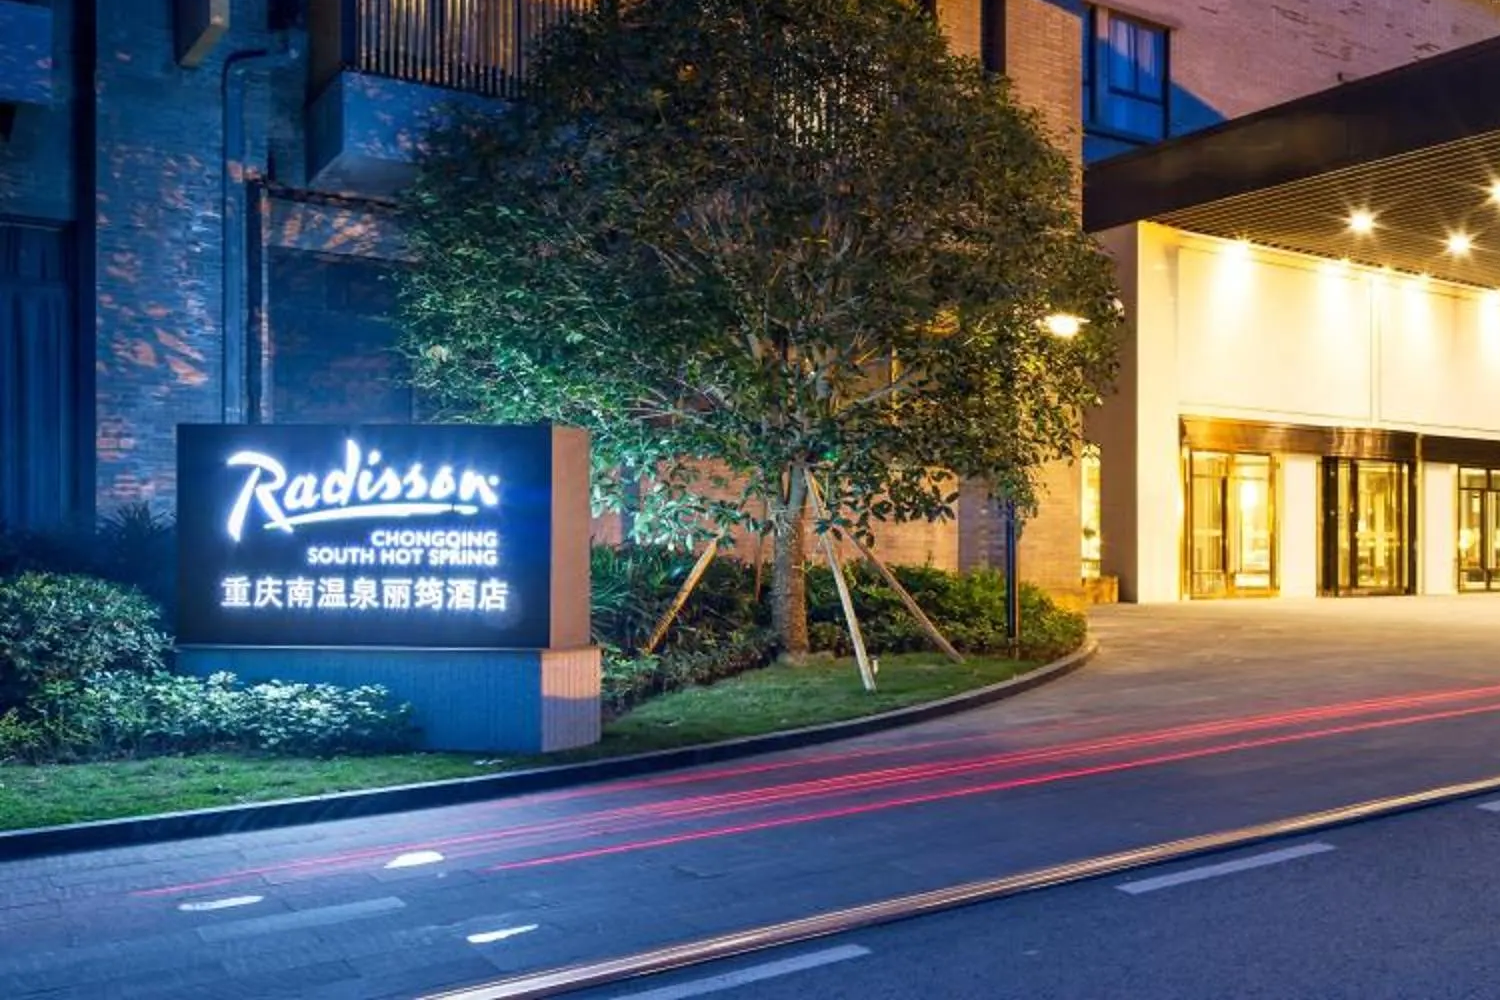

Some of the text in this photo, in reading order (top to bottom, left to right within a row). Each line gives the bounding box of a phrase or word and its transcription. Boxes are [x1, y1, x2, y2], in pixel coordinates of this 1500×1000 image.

[226, 438, 499, 542] Radisson
[370, 530, 498, 548] CHONGQING
[307, 547, 498, 566] SOUTH HOT SPRING
[220, 576, 509, 611] 重庆南温泉丽筠酒店
